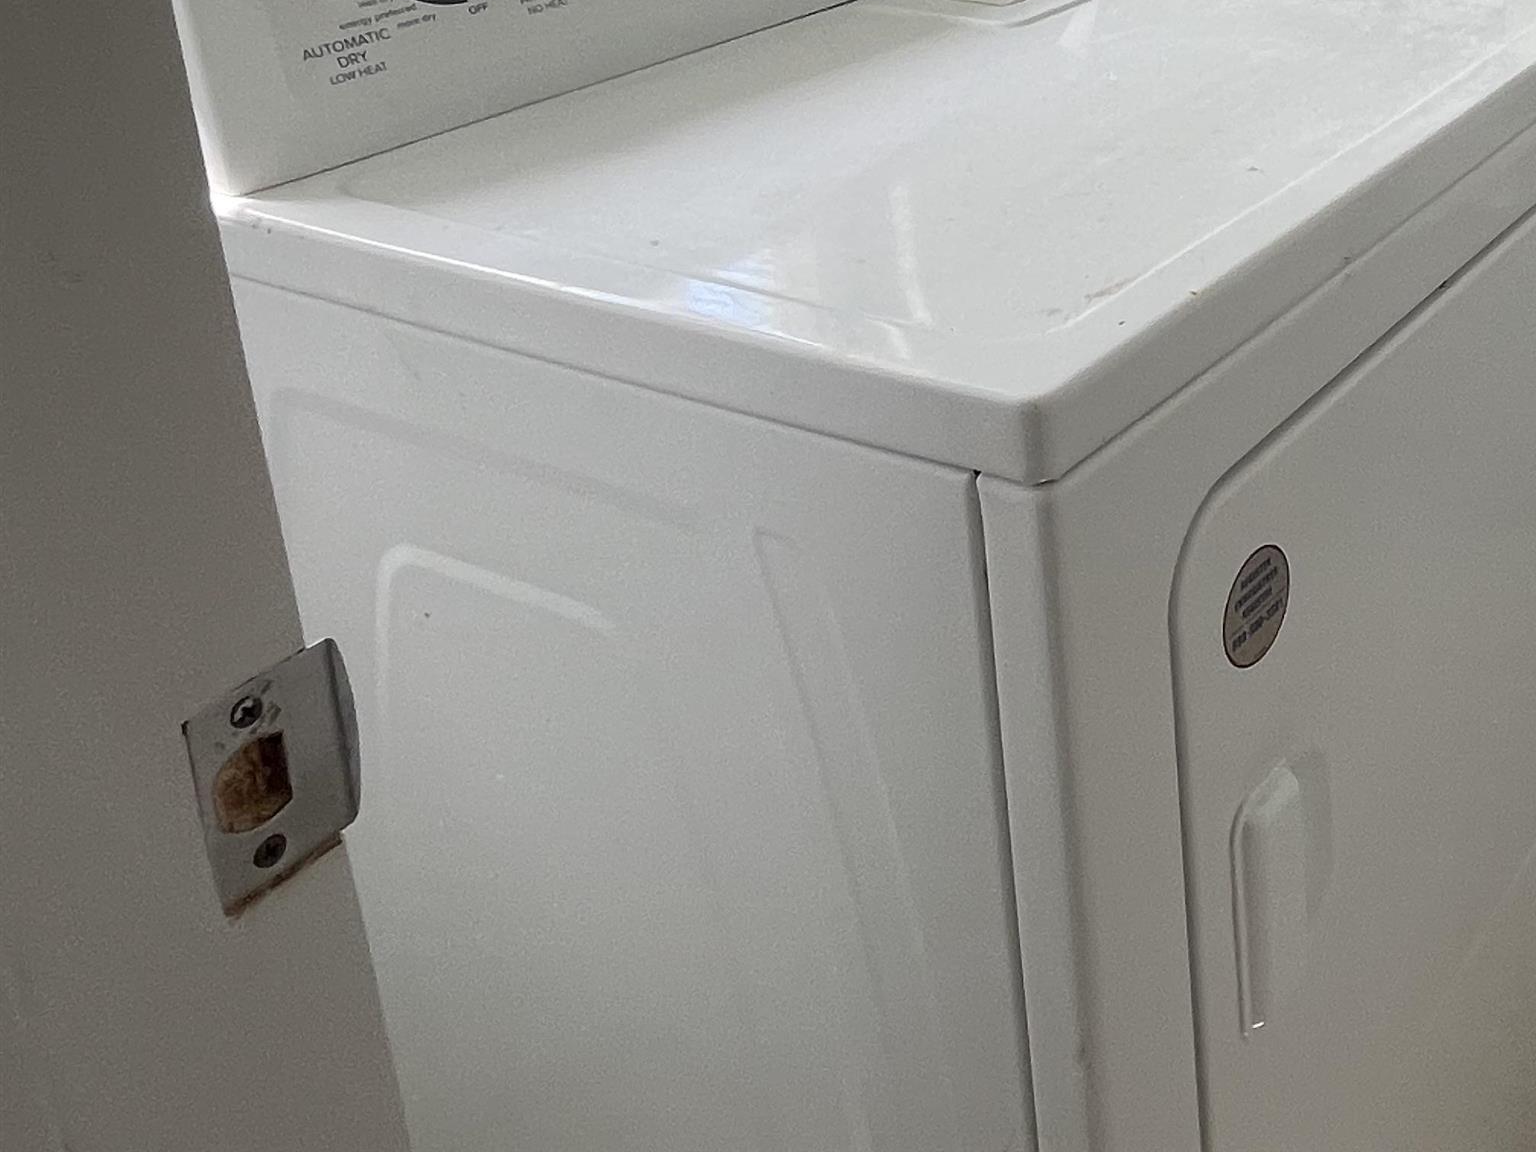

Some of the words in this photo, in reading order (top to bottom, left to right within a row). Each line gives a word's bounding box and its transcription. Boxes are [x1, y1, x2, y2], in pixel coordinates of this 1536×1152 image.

[468, 2, 488, 15] OFF
[303, 27, 391, 61] AUTOMATIC
[337, 50, 368, 68] DRY
[330, 70, 356, 85] LOW
[357, 61, 388, 78] HEAT
